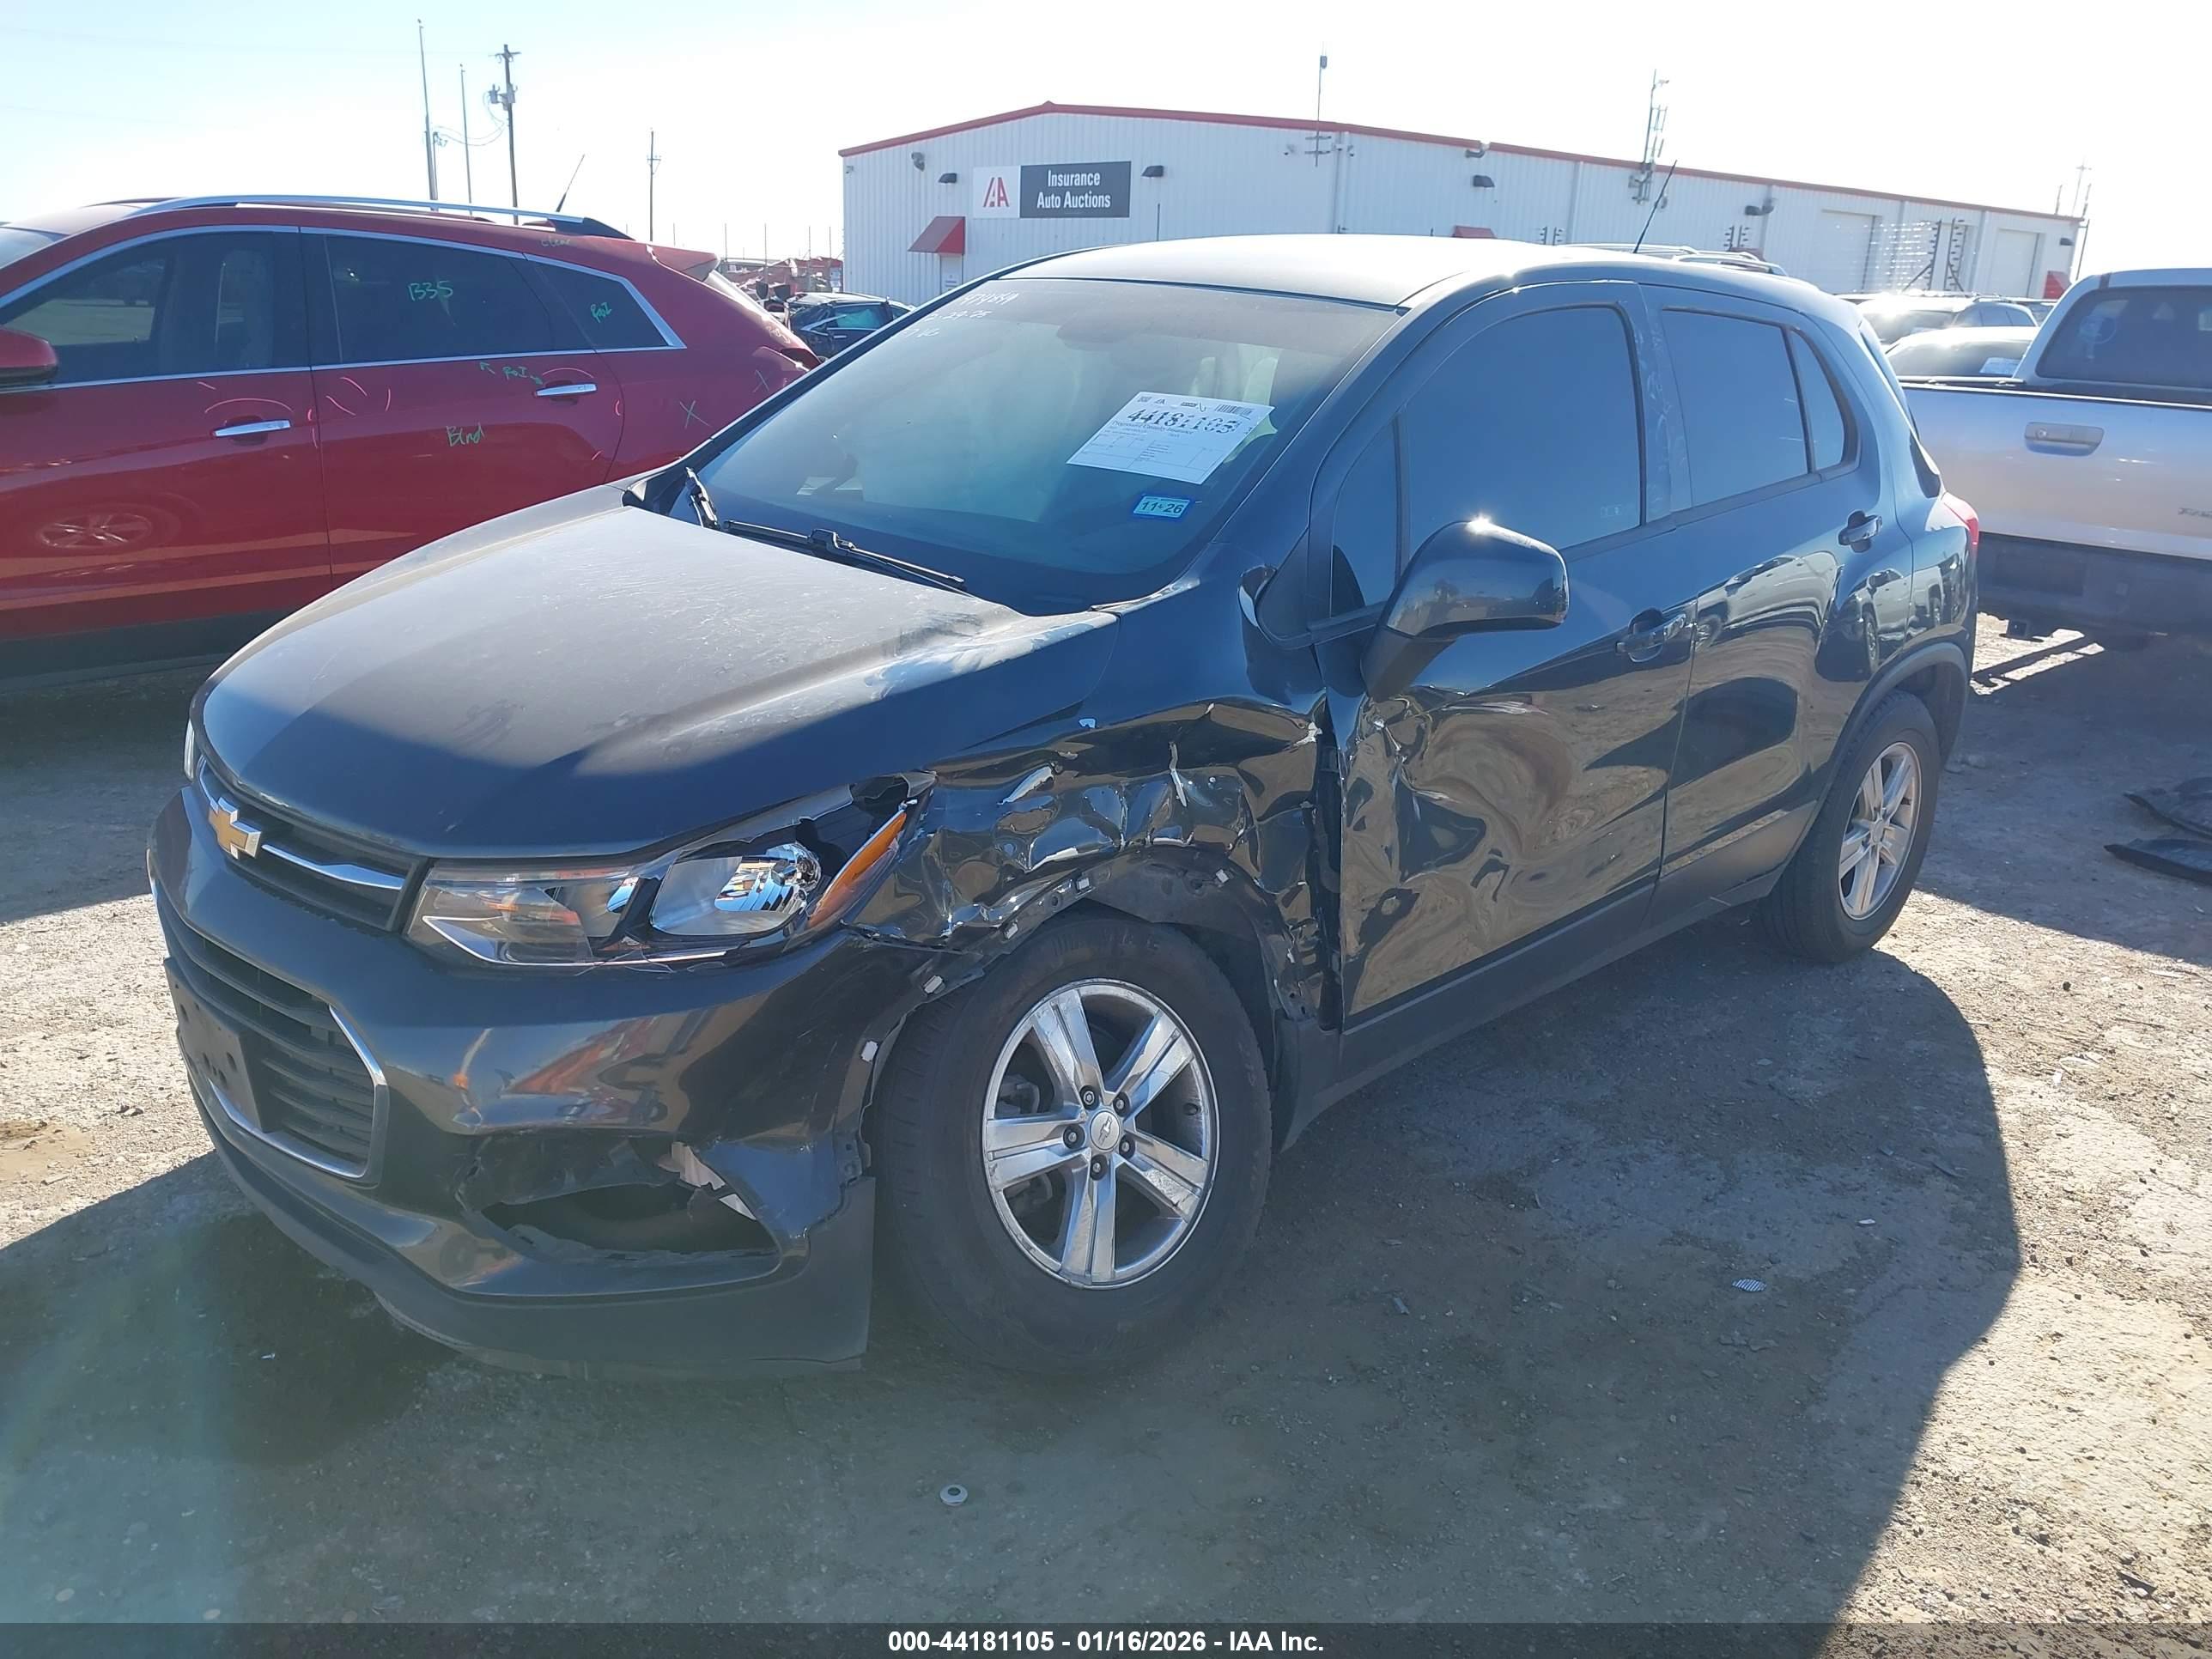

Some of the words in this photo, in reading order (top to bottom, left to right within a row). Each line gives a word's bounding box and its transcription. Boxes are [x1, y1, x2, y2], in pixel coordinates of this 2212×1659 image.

[1048, 169, 1101, 187] Insurance
[1036, 191, 1061, 209] Auto
[1063, 190, 1111, 209] Auctions
[1164, 503, 1184, 514] 26
